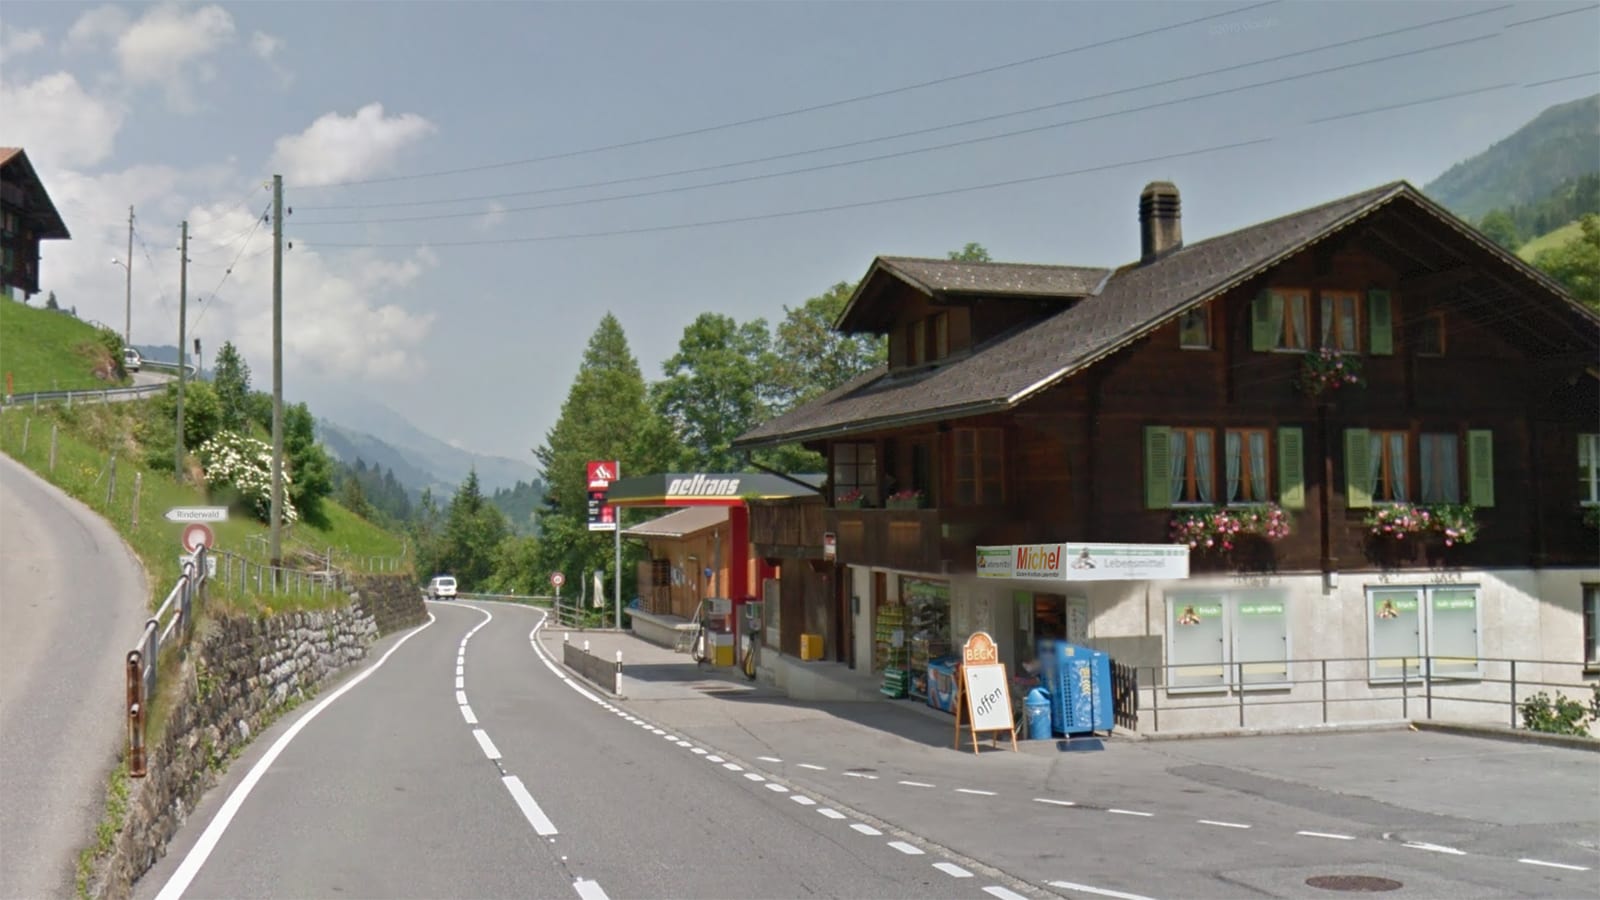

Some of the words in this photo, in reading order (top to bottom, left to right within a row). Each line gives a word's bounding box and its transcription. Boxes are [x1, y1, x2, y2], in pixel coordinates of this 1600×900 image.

[667, 474, 741, 496] oeltrans
[176, 511, 220, 519] Rinderwald
[1016, 546, 1061, 570] Michel
[966, 647, 995, 660] BECK
[976, 687, 1003, 717] offen
